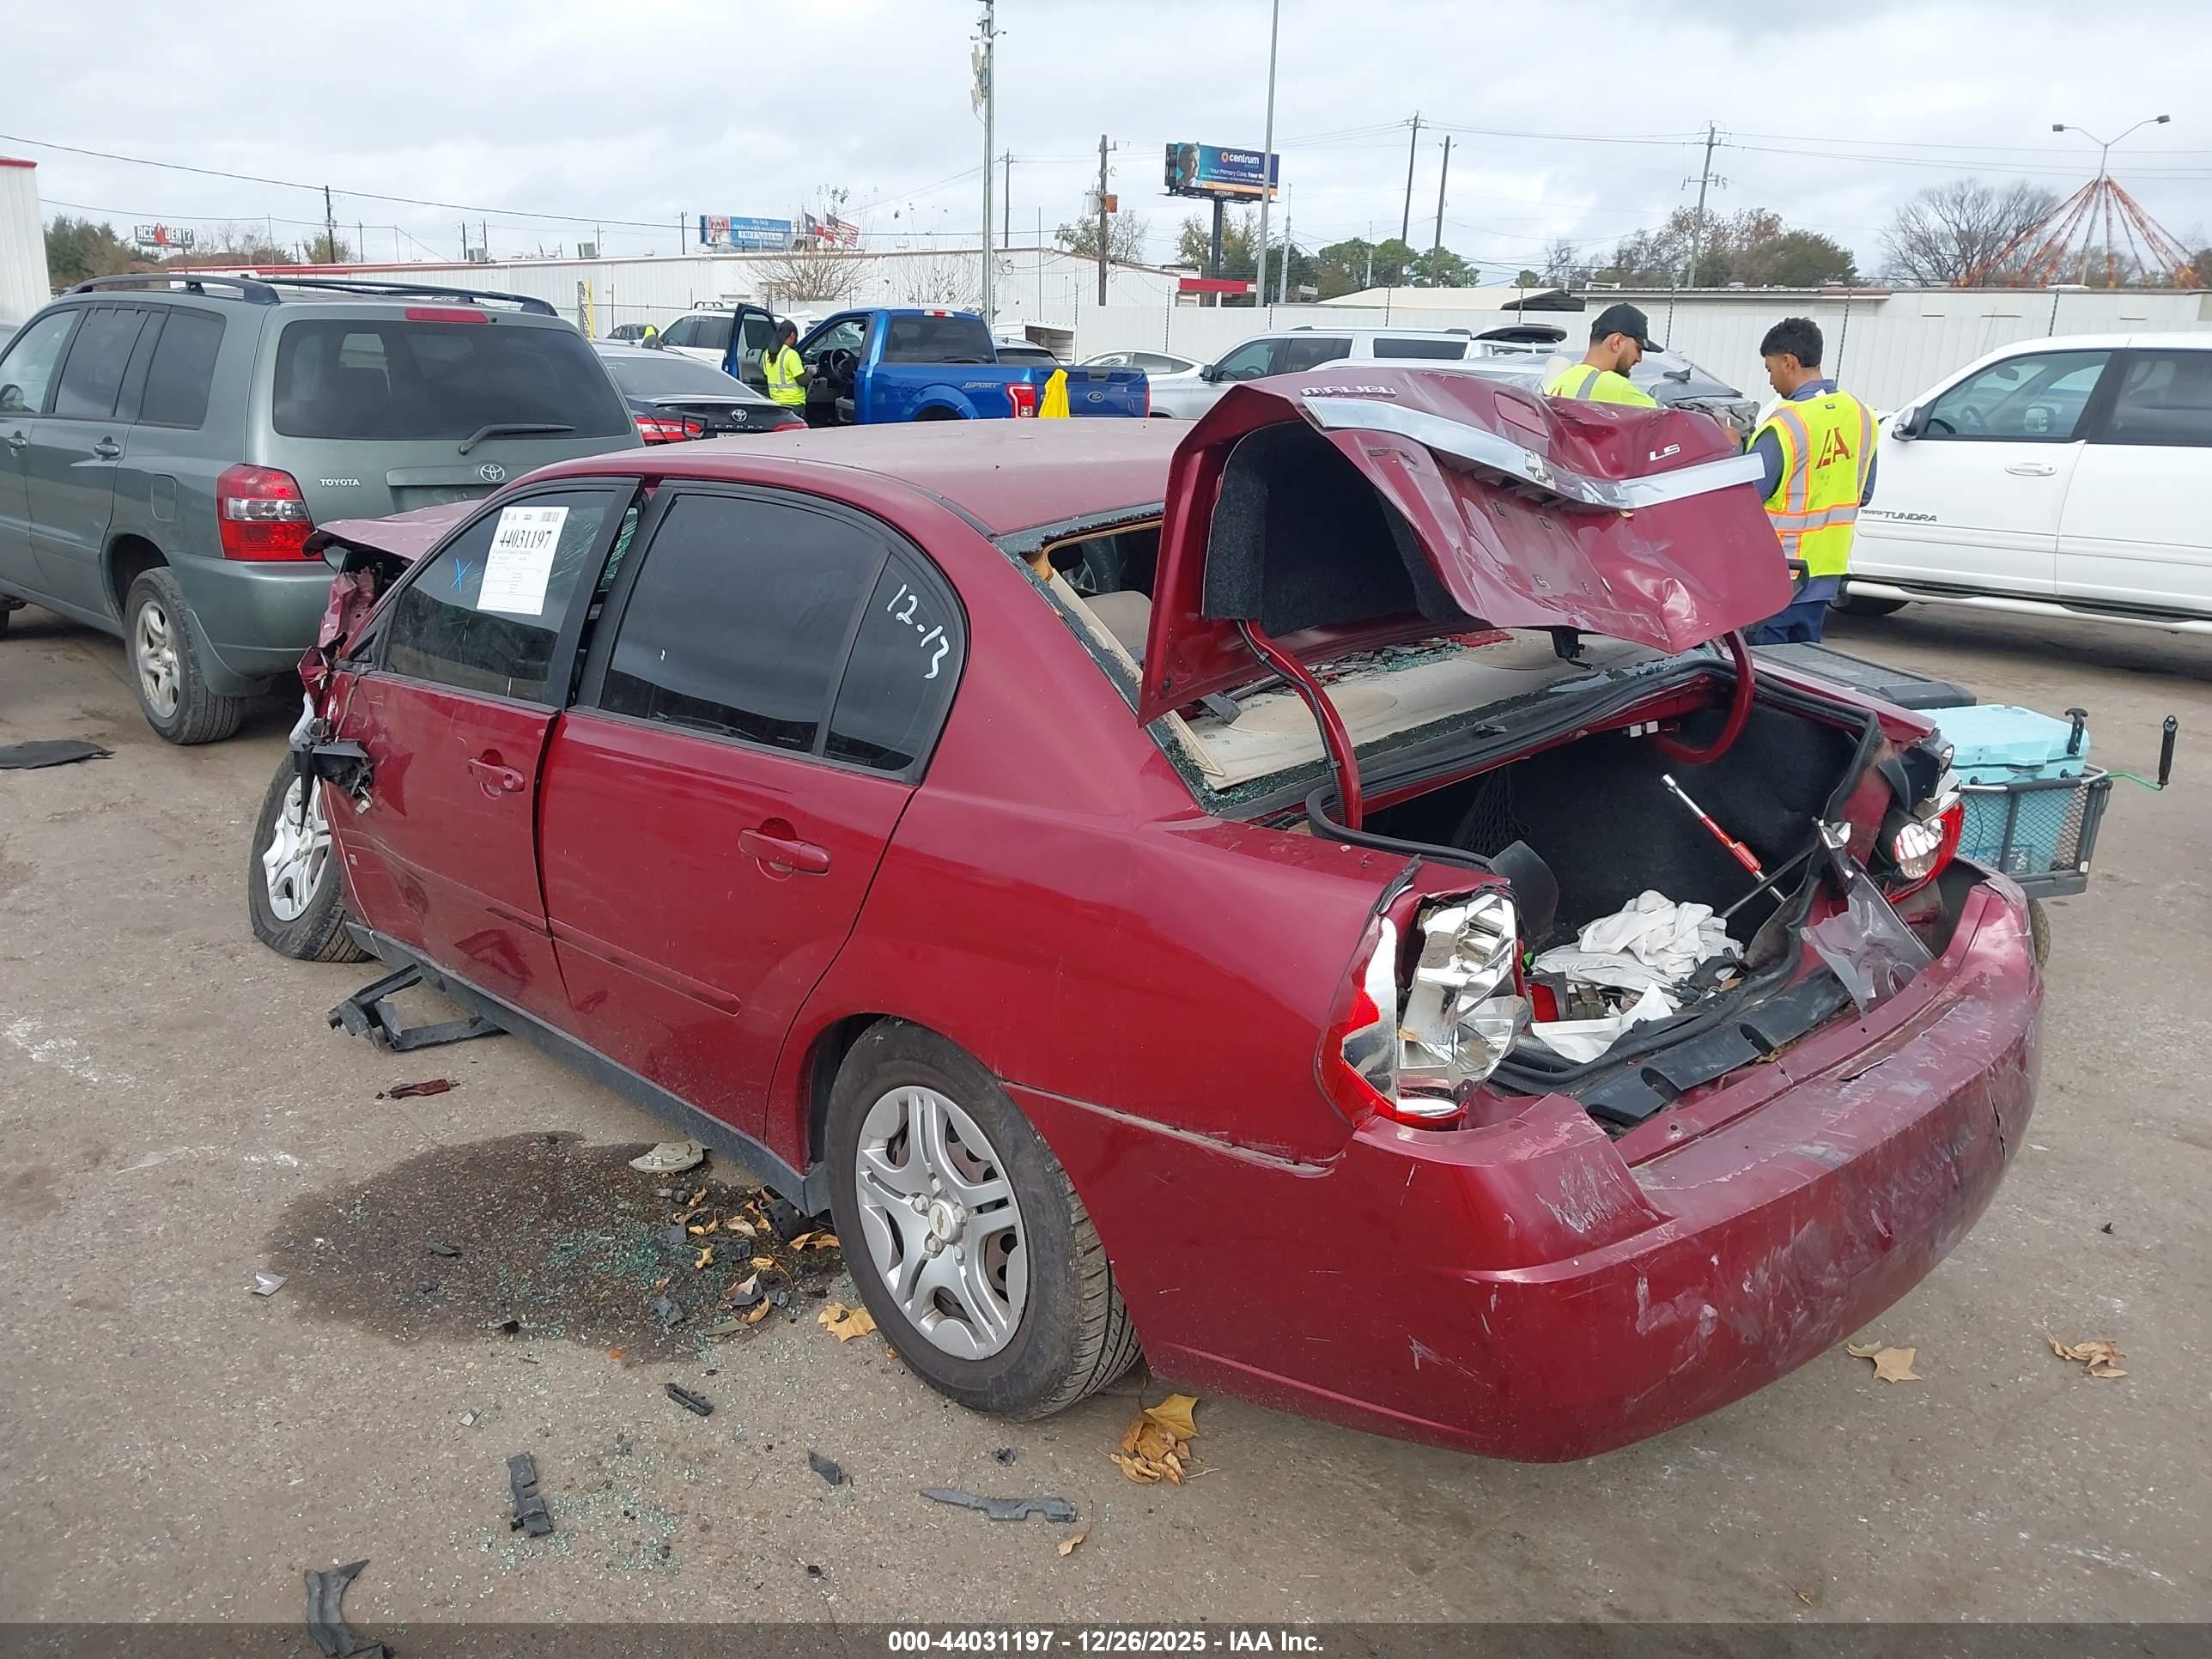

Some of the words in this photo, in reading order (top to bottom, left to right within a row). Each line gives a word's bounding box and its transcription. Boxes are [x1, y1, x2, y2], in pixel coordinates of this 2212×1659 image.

[1650, 443, 1680, 461] LS
[319, 478, 361, 487] TOYOTA
[1883, 511, 1937, 522] TUNDRA
[499, 529, 552, 550] 44031197
